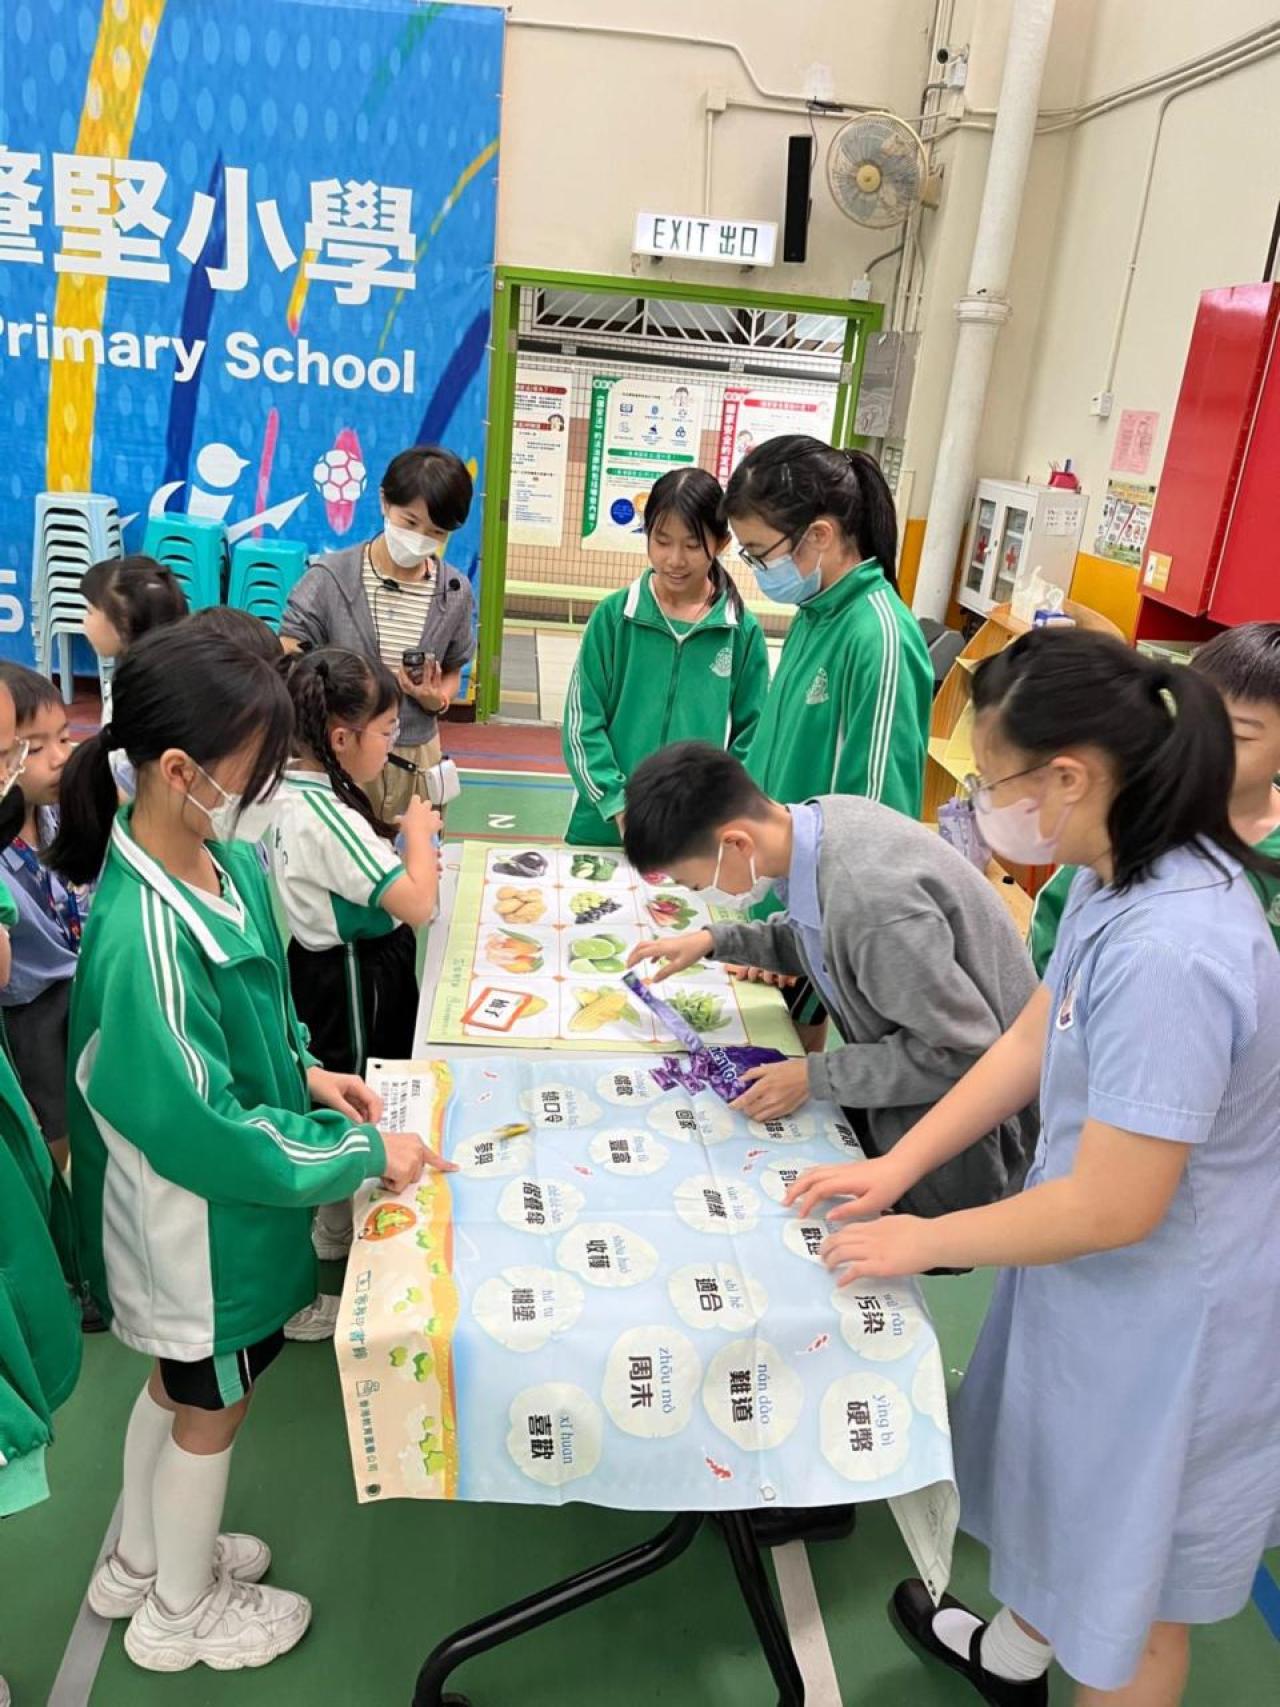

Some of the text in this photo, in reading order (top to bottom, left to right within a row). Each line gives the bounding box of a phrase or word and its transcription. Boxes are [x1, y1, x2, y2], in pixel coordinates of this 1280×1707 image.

[653, 218, 758, 257] EXIT 出口
[0, 313, 415, 394] rimary School
[676, 1110, 697, 1130] 回家
[703, 1189, 726, 1218] 訓練
[586, 1239, 610, 1269] 收穫
[512, 1288, 536, 1322] 糊塗
[694, 1278, 723, 1311] 適合
[855, 1296, 883, 1334] 污染
[629, 1355, 653, 1408] 周末
[659, 1348, 676, 1414] zhōu mò
[729, 1370, 753, 1423] 難道
[758, 1396, 772, 1424] dào
[847, 1401, 873, 1452] 硬幣
[528, 1414, 553, 1459] 喜歡
[561, 1432, 574, 1464] huan
